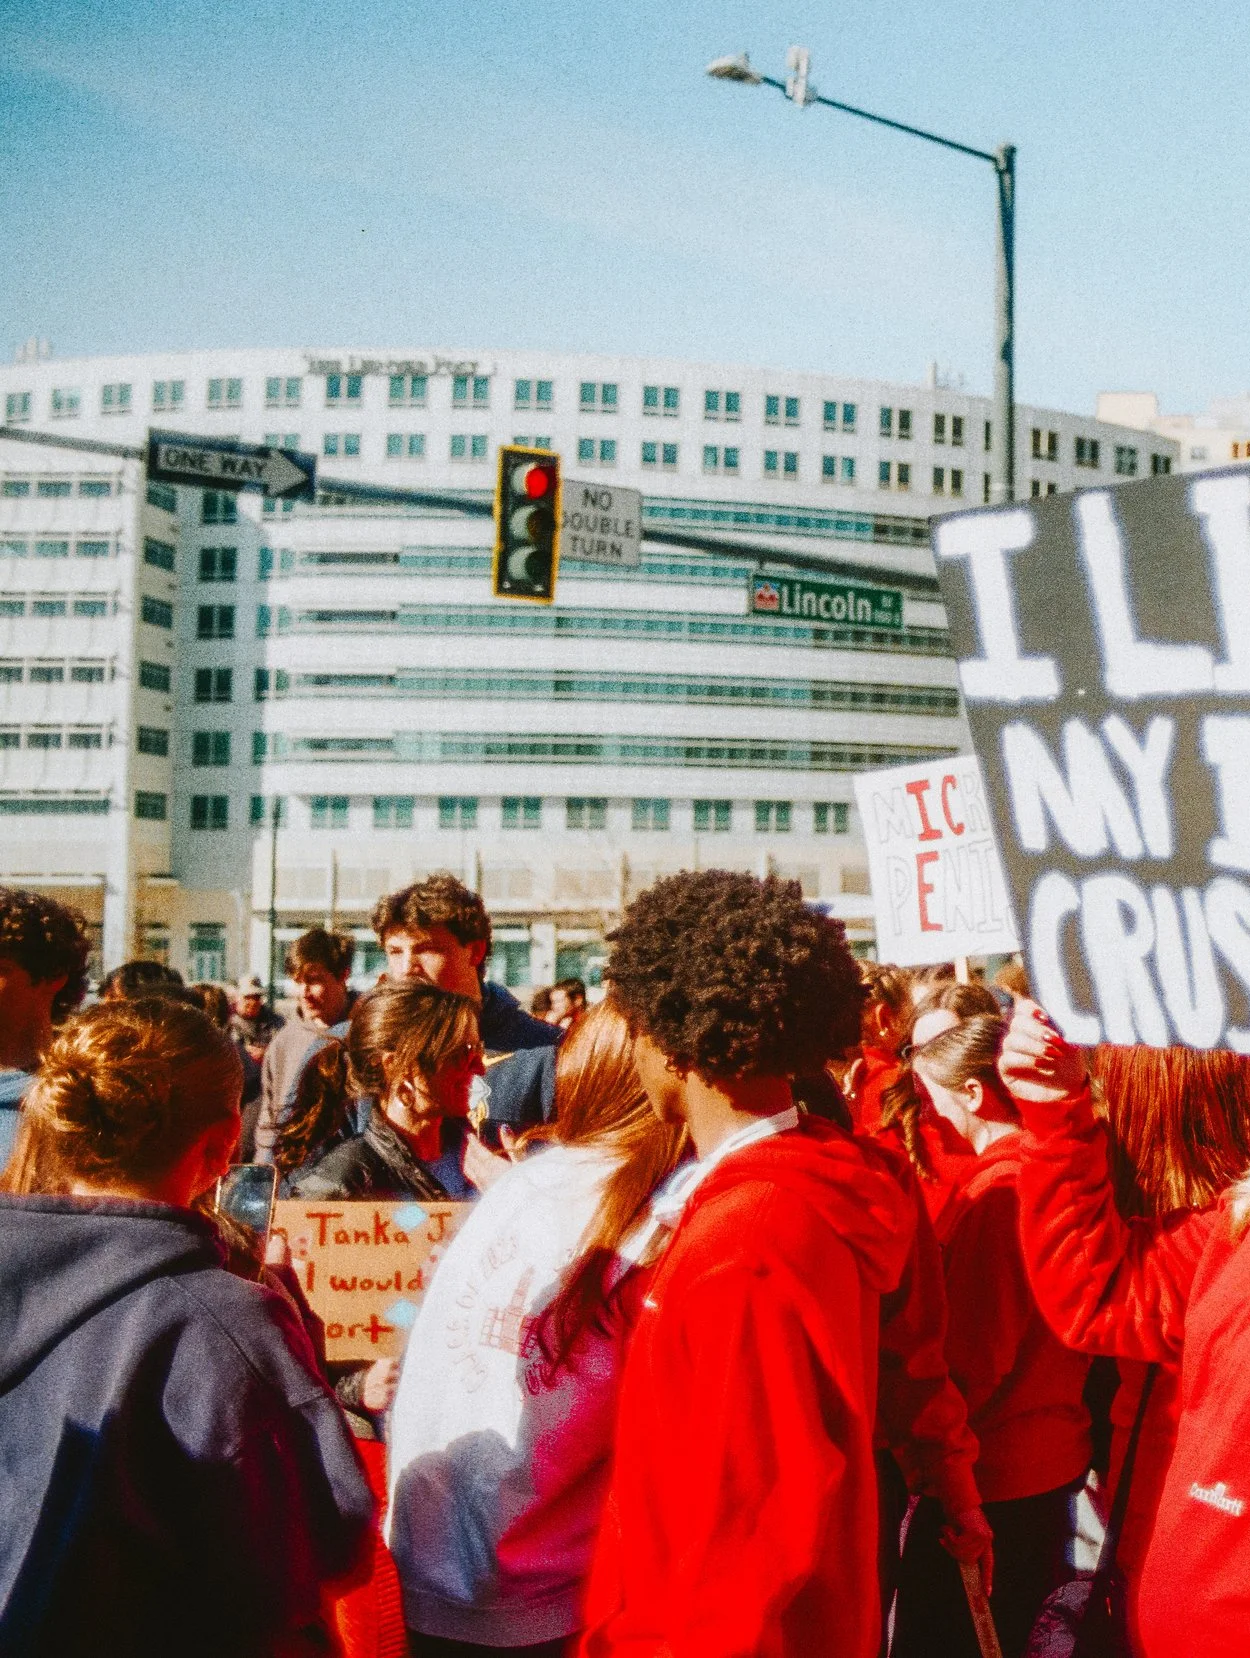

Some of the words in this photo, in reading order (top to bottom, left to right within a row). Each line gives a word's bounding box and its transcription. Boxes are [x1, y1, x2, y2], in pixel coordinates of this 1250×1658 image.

[165, 448, 208, 473] ONE
[220, 456, 266, 477] WAY
[581, 487, 612, 511] NO
[570, 535, 622, 557] TURN
[781, 583, 872, 622] Lincoln
[935, 510, 1060, 700] I
[1003, 714, 1176, 860] MY
[305, 1210, 411, 1247] Tanka
[329, 1268, 424, 1293] would
